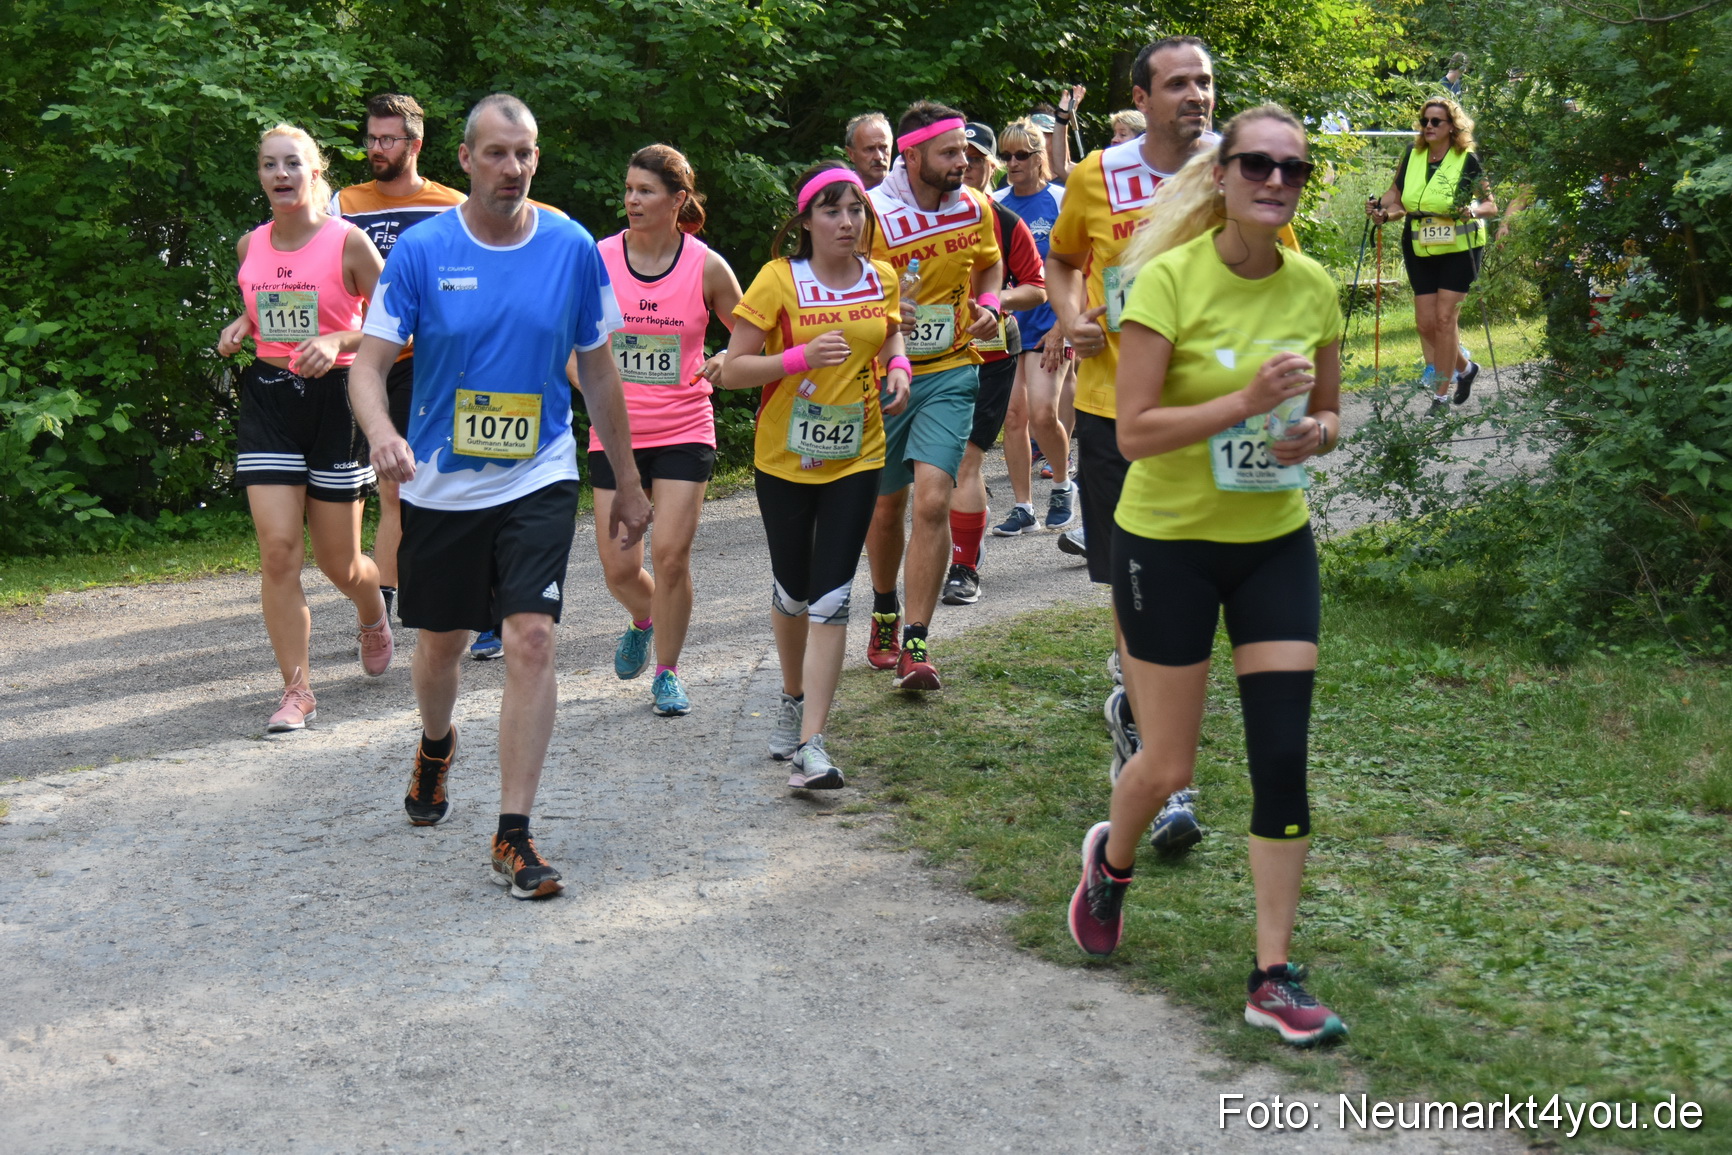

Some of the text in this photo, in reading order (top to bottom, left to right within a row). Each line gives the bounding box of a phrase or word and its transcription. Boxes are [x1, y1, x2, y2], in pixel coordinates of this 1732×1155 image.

[1422, 226, 1451, 238] 1512
[890, 230, 982, 270] MAX BÖGL
[277, 266, 293, 279] Die
[251, 281, 316, 292] Kieferorthopäden
[639, 298, 658, 312] Die
[265, 309, 311, 328] 1115
[800, 305, 886, 327] MAX BÖGL
[908, 323, 946, 341] 637
[619, 350, 671, 371] 1118
[466, 414, 529, 441] 1070
[799, 420, 855, 444] 1642
[467, 437, 502, 447] Guthmann
[1221, 440, 1288, 470] 123
